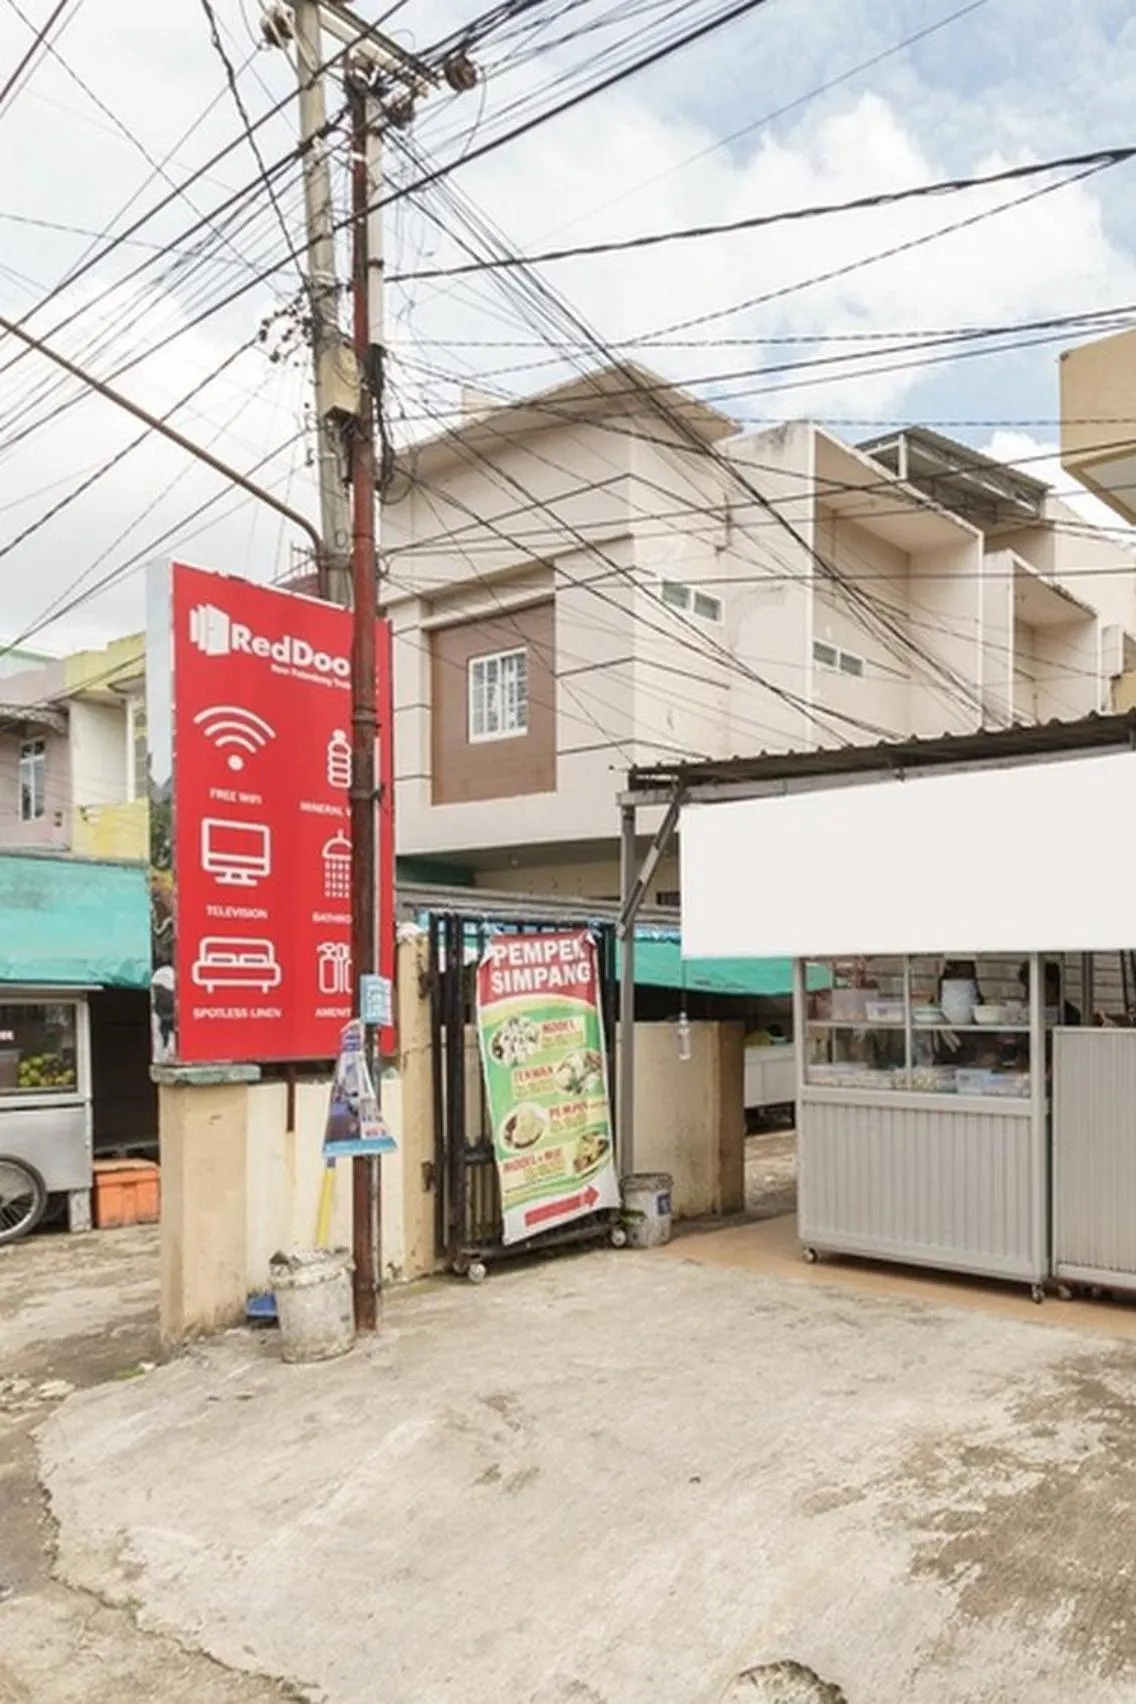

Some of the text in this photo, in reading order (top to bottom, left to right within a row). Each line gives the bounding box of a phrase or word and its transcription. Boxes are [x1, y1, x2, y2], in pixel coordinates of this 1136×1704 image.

[230, 622, 351, 678] RedDoo
[209, 787, 237, 804] FREE
[299, 800, 343, 817] MINERAL
[206, 904, 268, 920] TELEVISION
[491, 935, 586, 967] PEMPEK
[489, 961, 592, 994] SIMPANG
[193, 1006, 283, 1020] SPOTLESS LINEN
